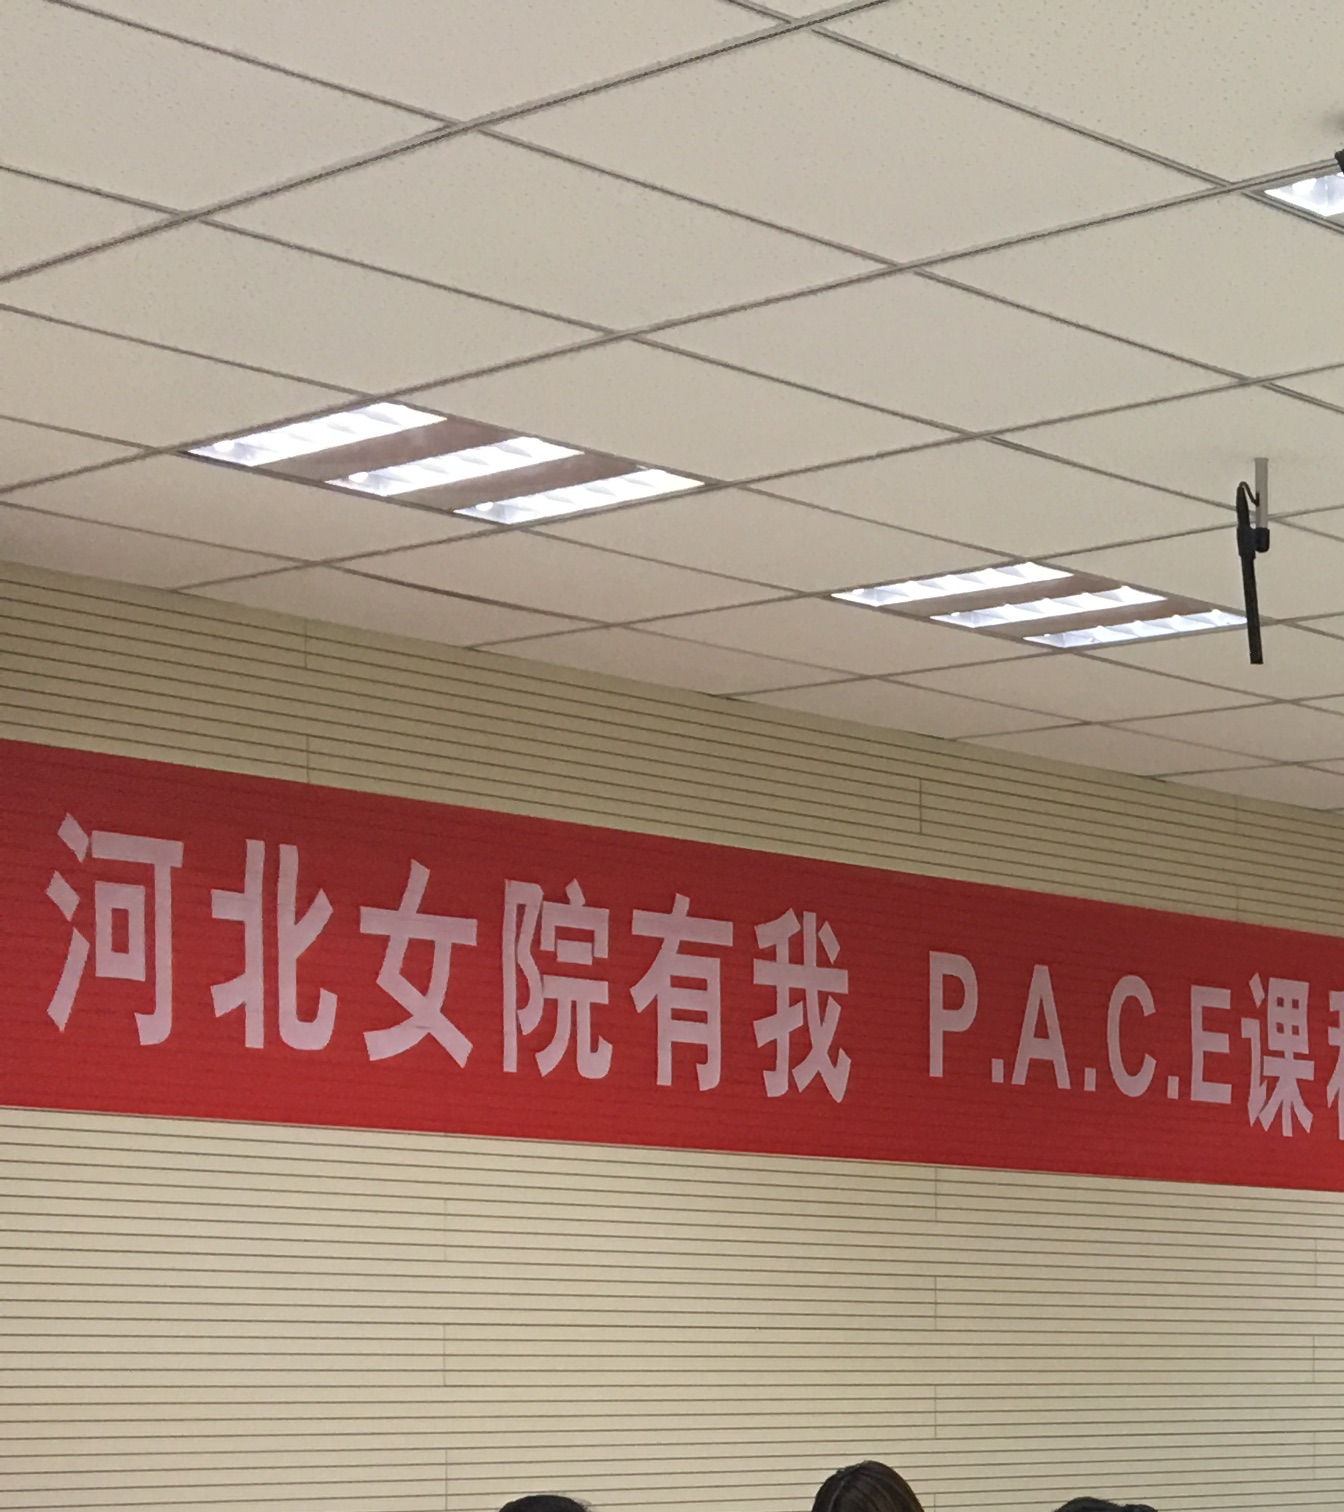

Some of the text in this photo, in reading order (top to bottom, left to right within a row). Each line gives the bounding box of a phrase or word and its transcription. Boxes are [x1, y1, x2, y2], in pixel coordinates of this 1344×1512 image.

[45, 812, 852, 1103] 河北女院有我
